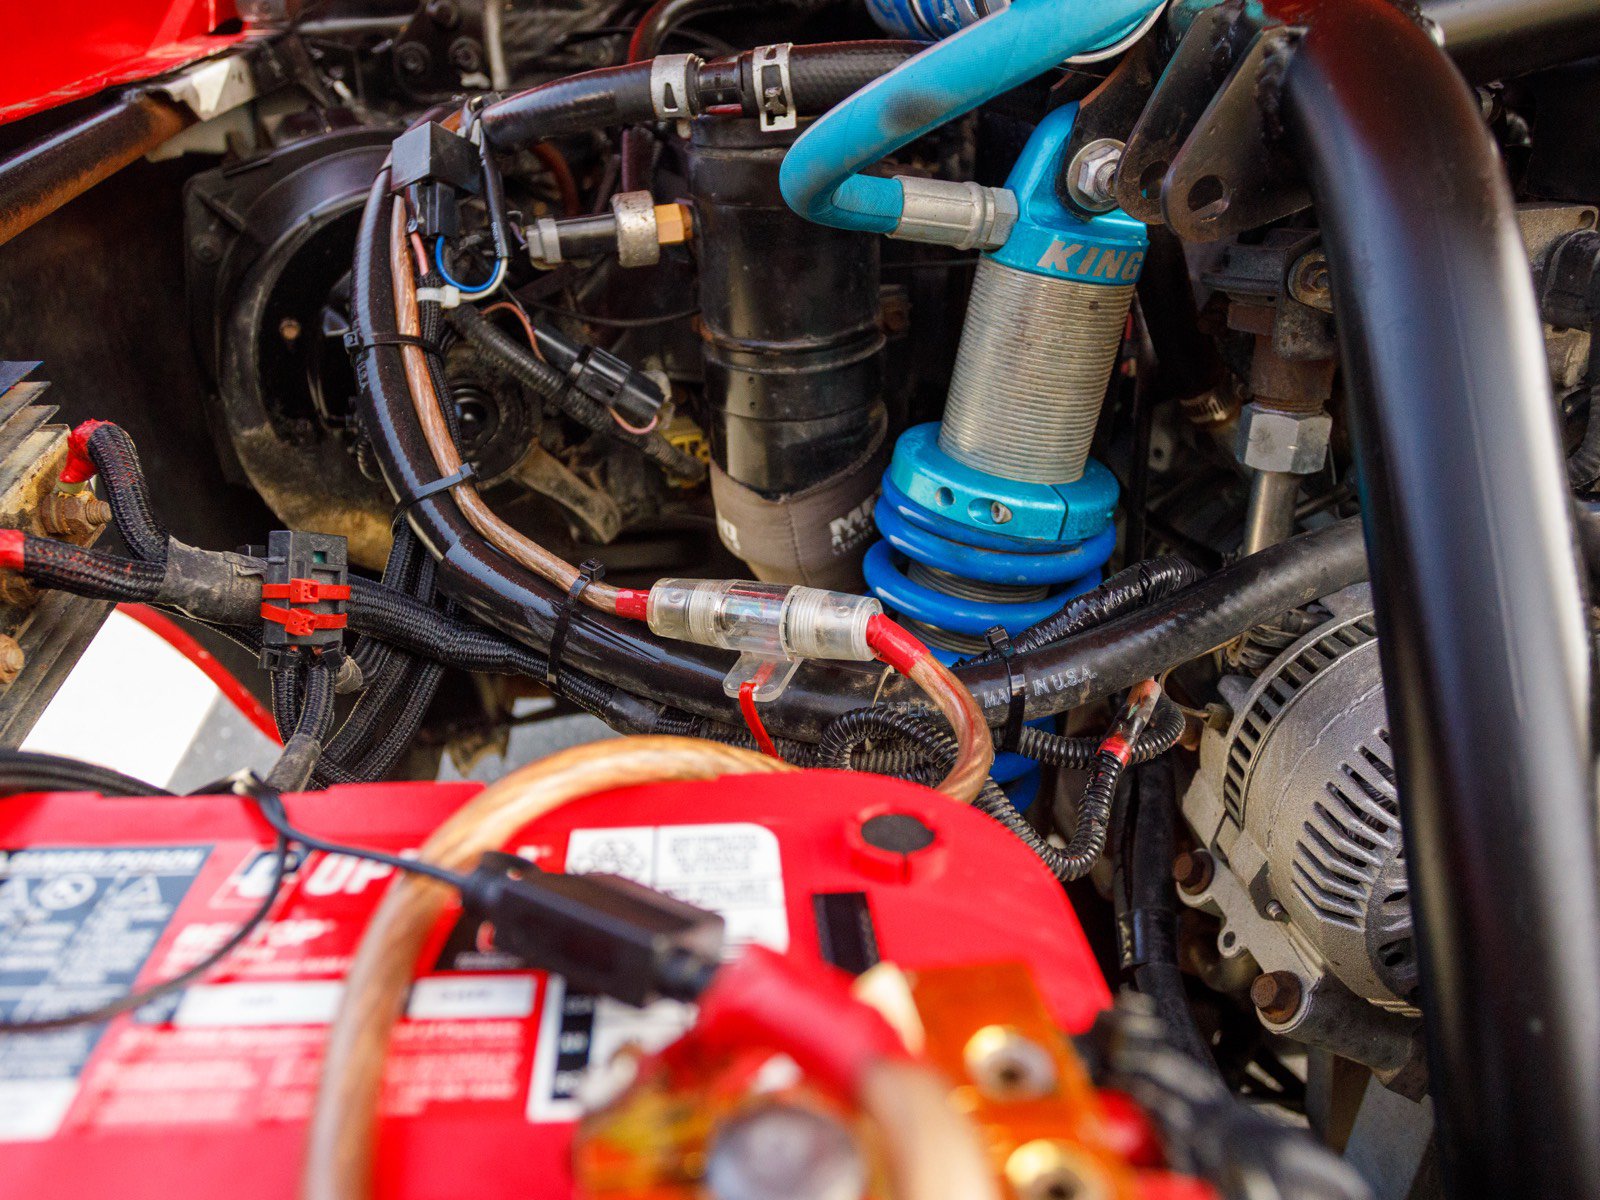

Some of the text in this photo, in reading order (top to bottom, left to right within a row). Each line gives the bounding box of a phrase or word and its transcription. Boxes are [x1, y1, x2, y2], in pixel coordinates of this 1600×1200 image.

[1036, 240, 1144, 280] KING
[1032, 677, 1050, 697] IN
[1051, 663, 1098, 691] U.S.A.
